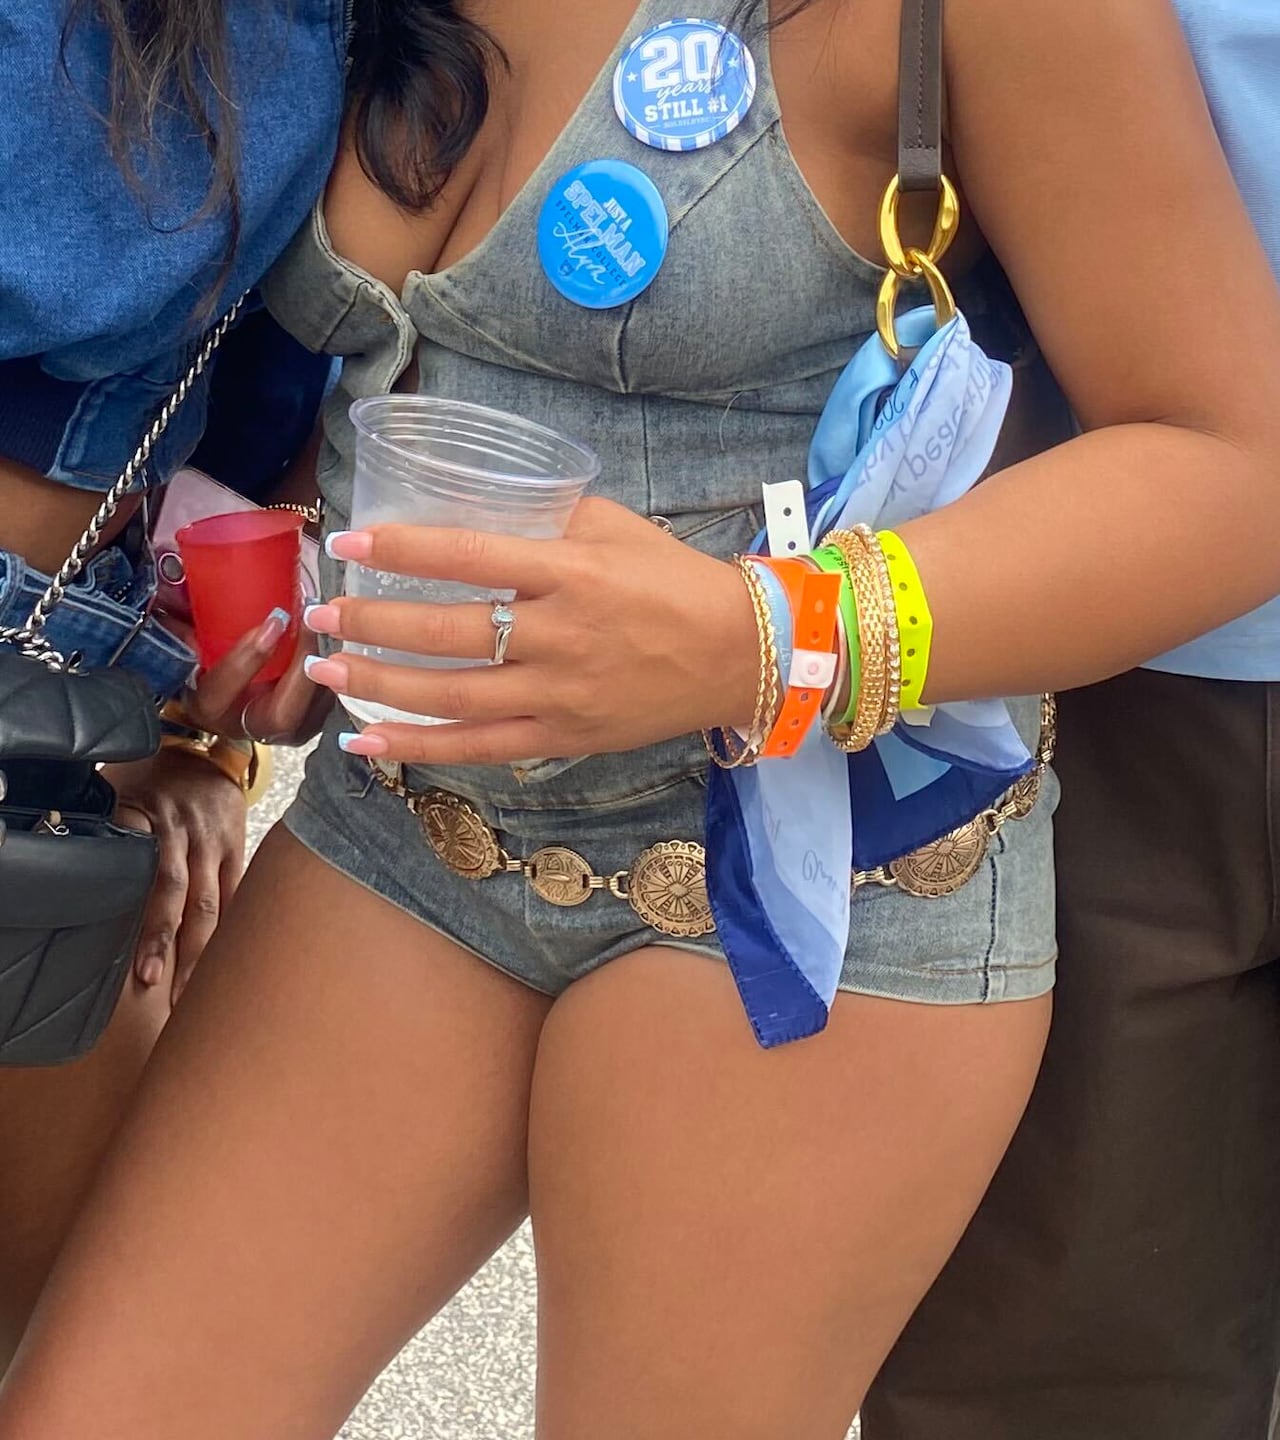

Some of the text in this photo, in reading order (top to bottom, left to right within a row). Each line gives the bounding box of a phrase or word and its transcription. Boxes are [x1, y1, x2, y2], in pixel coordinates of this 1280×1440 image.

[639, 30, 724, 93] 20
[644, 98, 704, 123] STILL
[707, 94, 728, 114] #1
[657, 78, 718, 105] years
[563, 179, 647, 278] SPELMAN
[603, 197, 633, 233] JUST A
